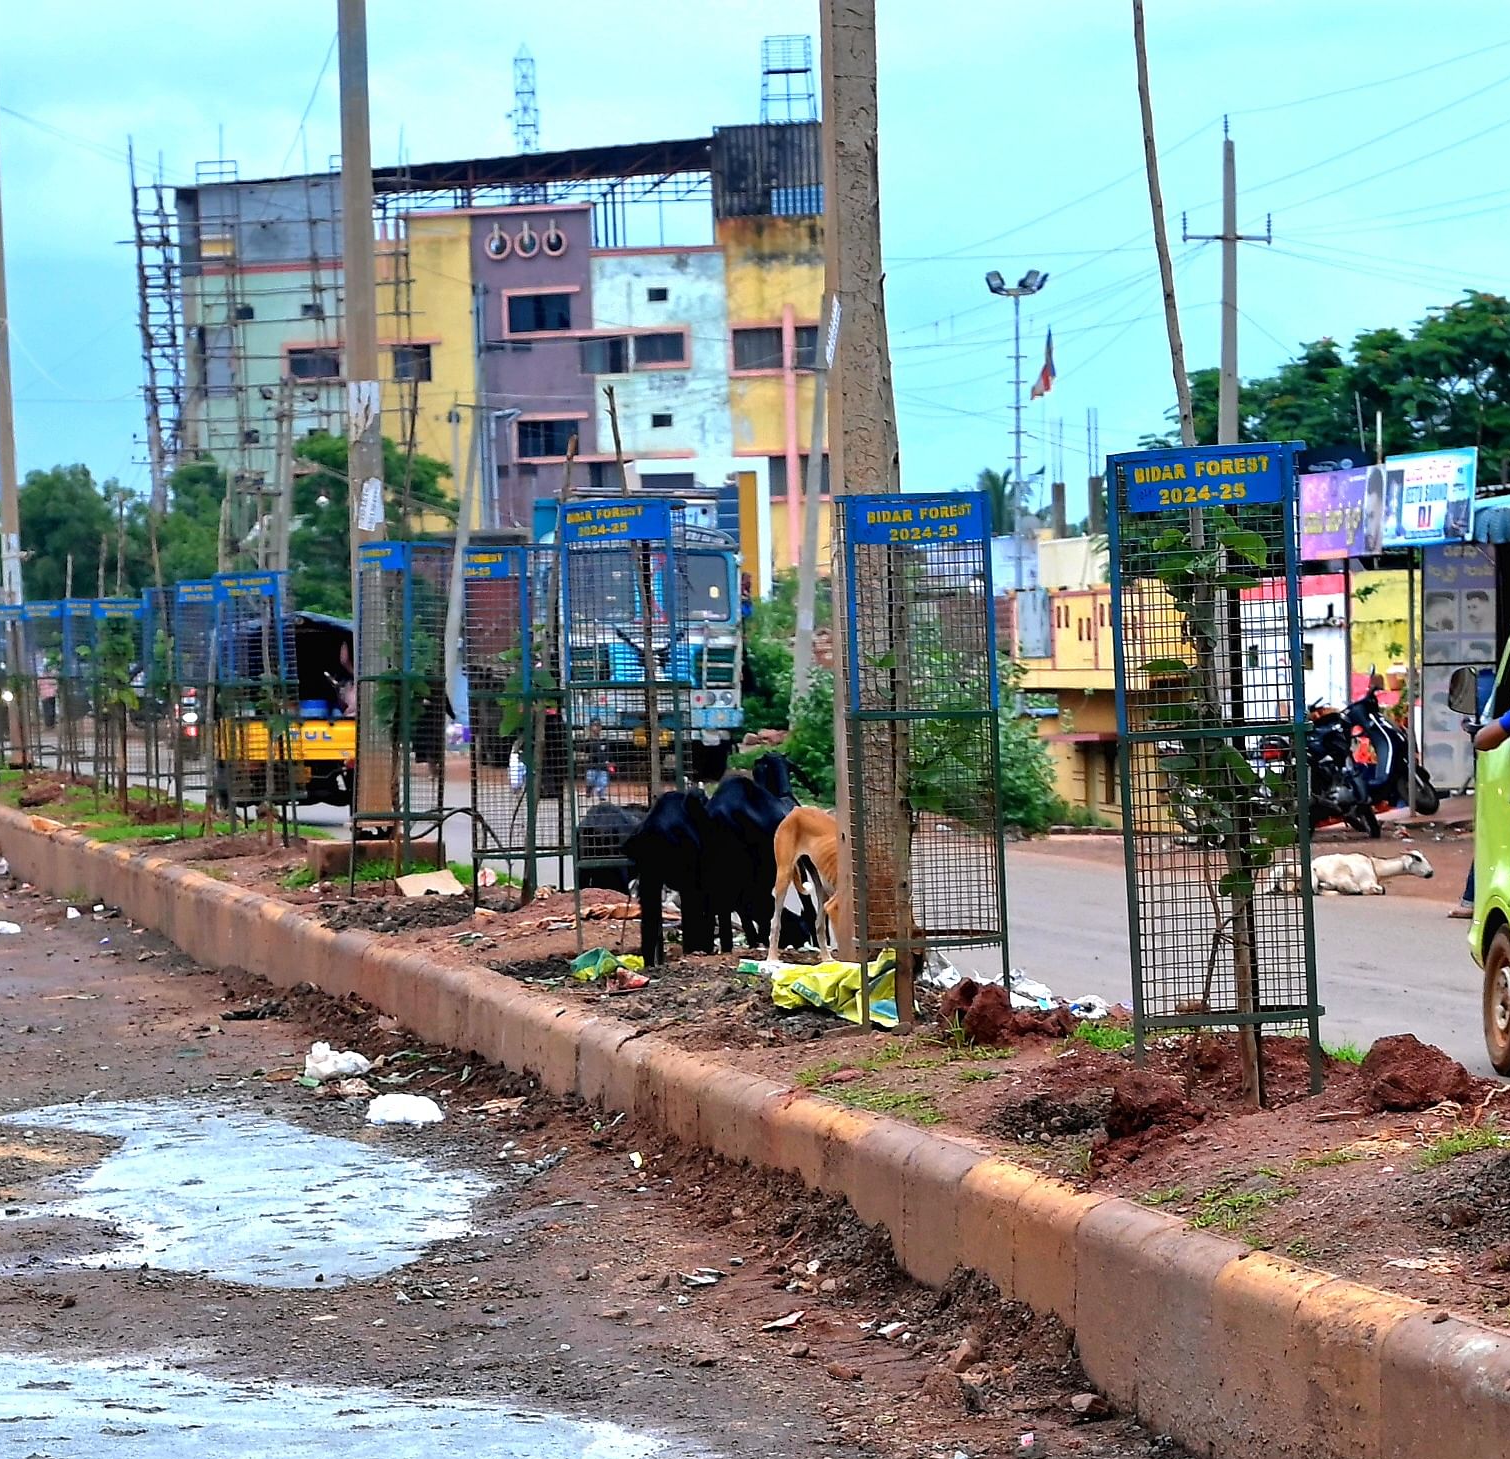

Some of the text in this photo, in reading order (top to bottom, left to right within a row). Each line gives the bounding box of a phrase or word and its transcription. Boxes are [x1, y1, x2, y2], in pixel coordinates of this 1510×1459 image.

[1134, 455, 1269, 484] BIDAR FOREST
[1159, 482, 1246, 505] 2024-25
[867, 503, 972, 524] BIDAR FOREST
[889, 524, 959, 541] 2024-25
